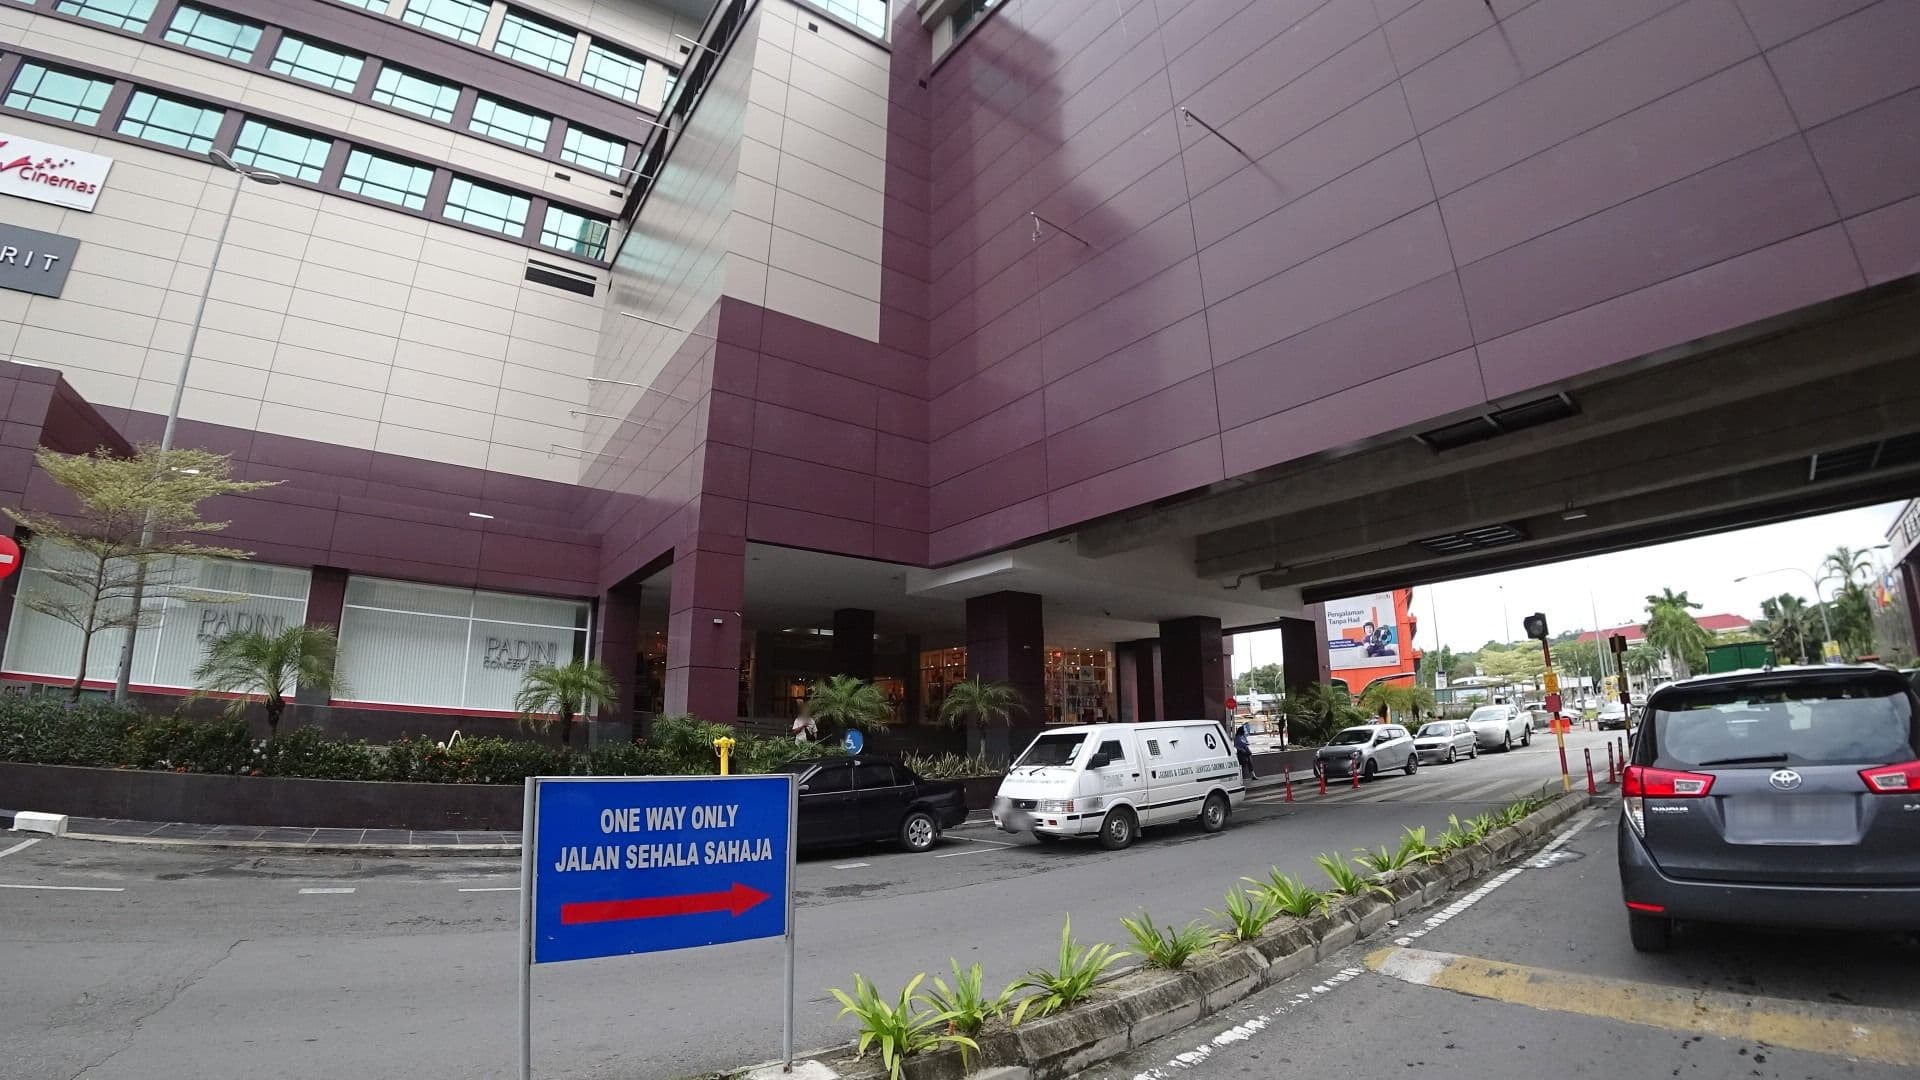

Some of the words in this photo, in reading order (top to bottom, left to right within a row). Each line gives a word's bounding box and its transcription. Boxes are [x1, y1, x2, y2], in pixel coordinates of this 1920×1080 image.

[19, 166, 97, 194] Cinemas
[199, 608, 285, 640] PADINI
[1328, 610, 1364, 620] Pengalaman
[1347, 616, 1360, 624] Had
[485, 637, 558, 662] PADINI
[600, 808, 640, 834] ONE
[646, 806, 687, 831] WAY
[691, 804, 739, 830] ONLY
[555, 846, 620, 873] JALAN
[625, 842, 699, 870] SEHALA
[704, 838, 772, 865] SAHAJA
